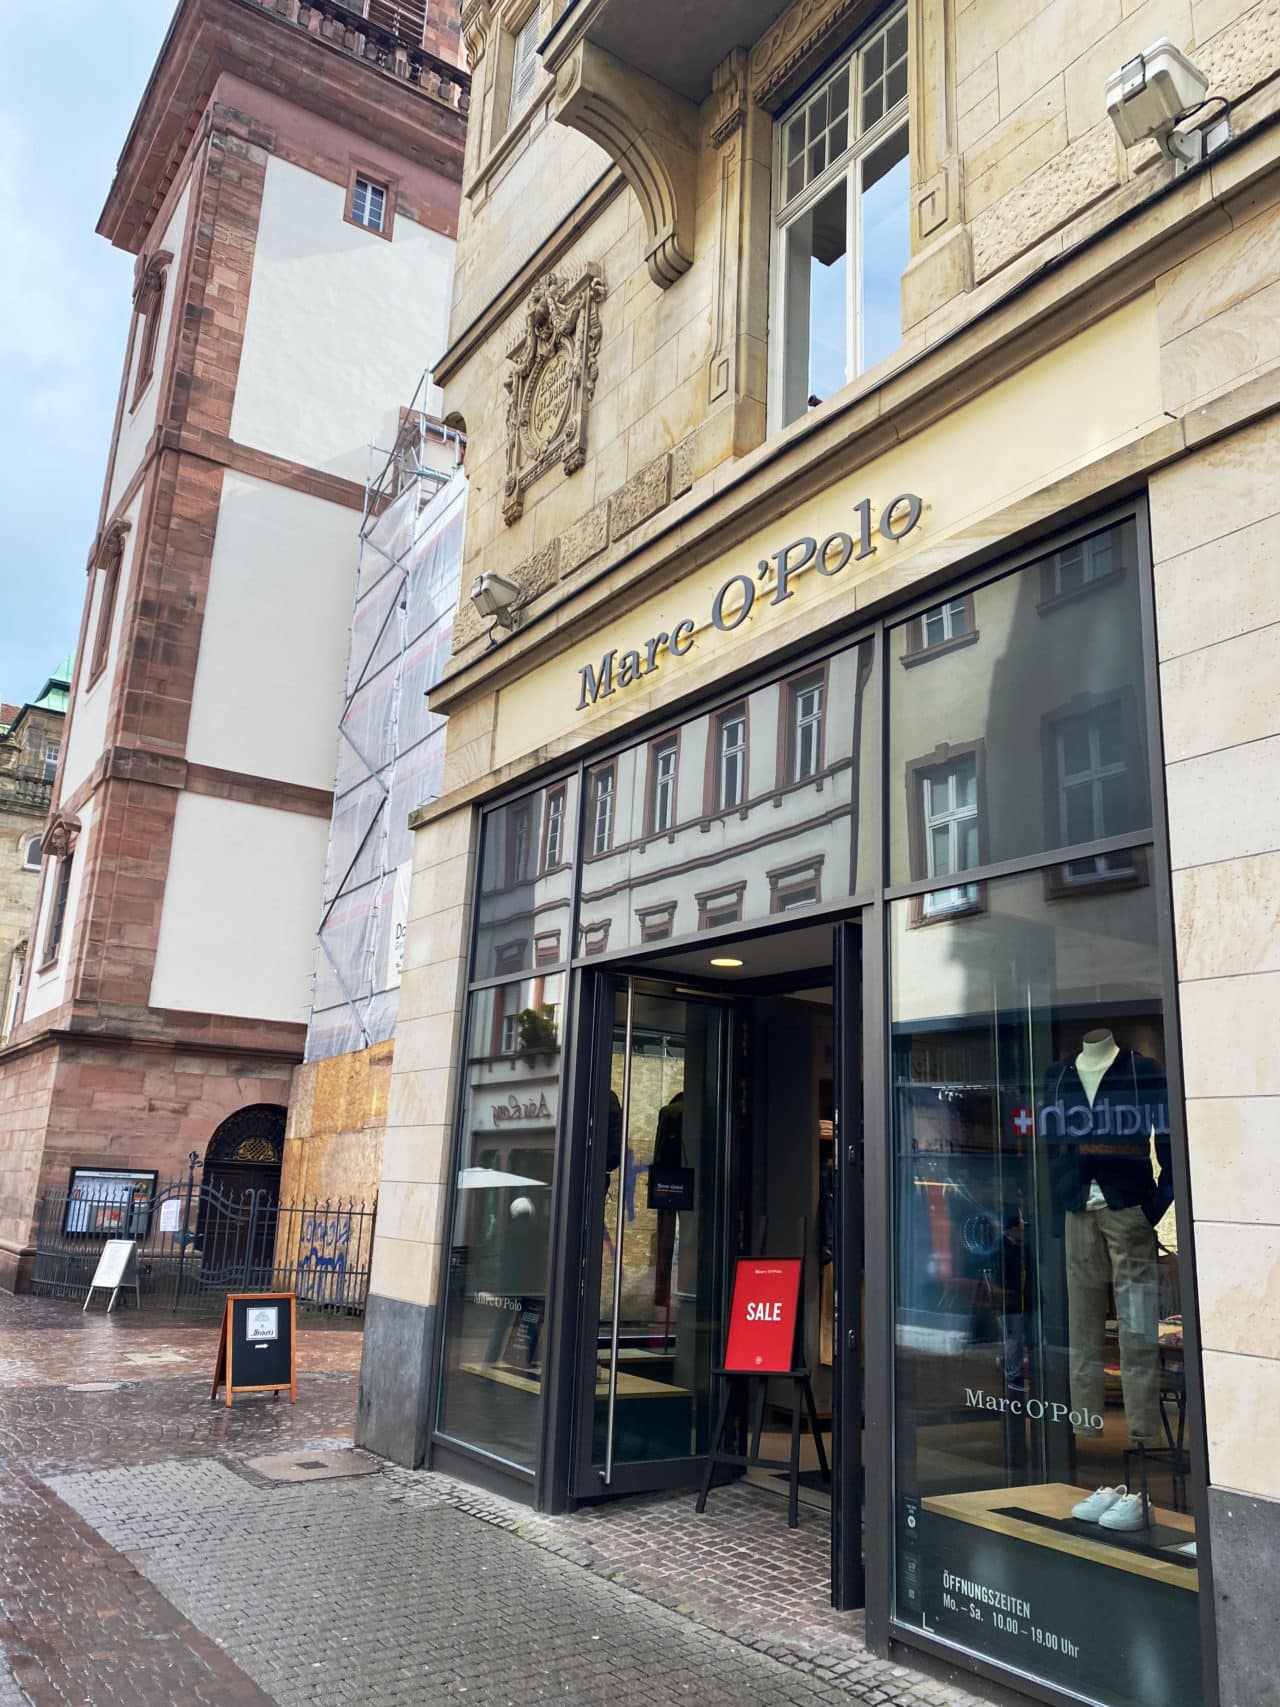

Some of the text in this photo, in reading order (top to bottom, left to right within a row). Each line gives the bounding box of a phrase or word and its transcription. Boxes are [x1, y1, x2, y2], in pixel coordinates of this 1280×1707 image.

[575, 493, 924, 712] Marc O'Polo
[746, 1302, 782, 1321] SALE
[964, 1388, 1105, 1430] Marc O'Polo
[943, 1569, 1031, 1619] ÖFFNUNGSZEITEN
[943, 1592, 959, 1612] Mo.
[969, 1603, 984, 1622] Sa.
[992, 1612, 1019, 1635] 10.00
[1031, 1626, 1059, 1651] 19.00
[1060, 1636, 1080, 1659] Uhr
